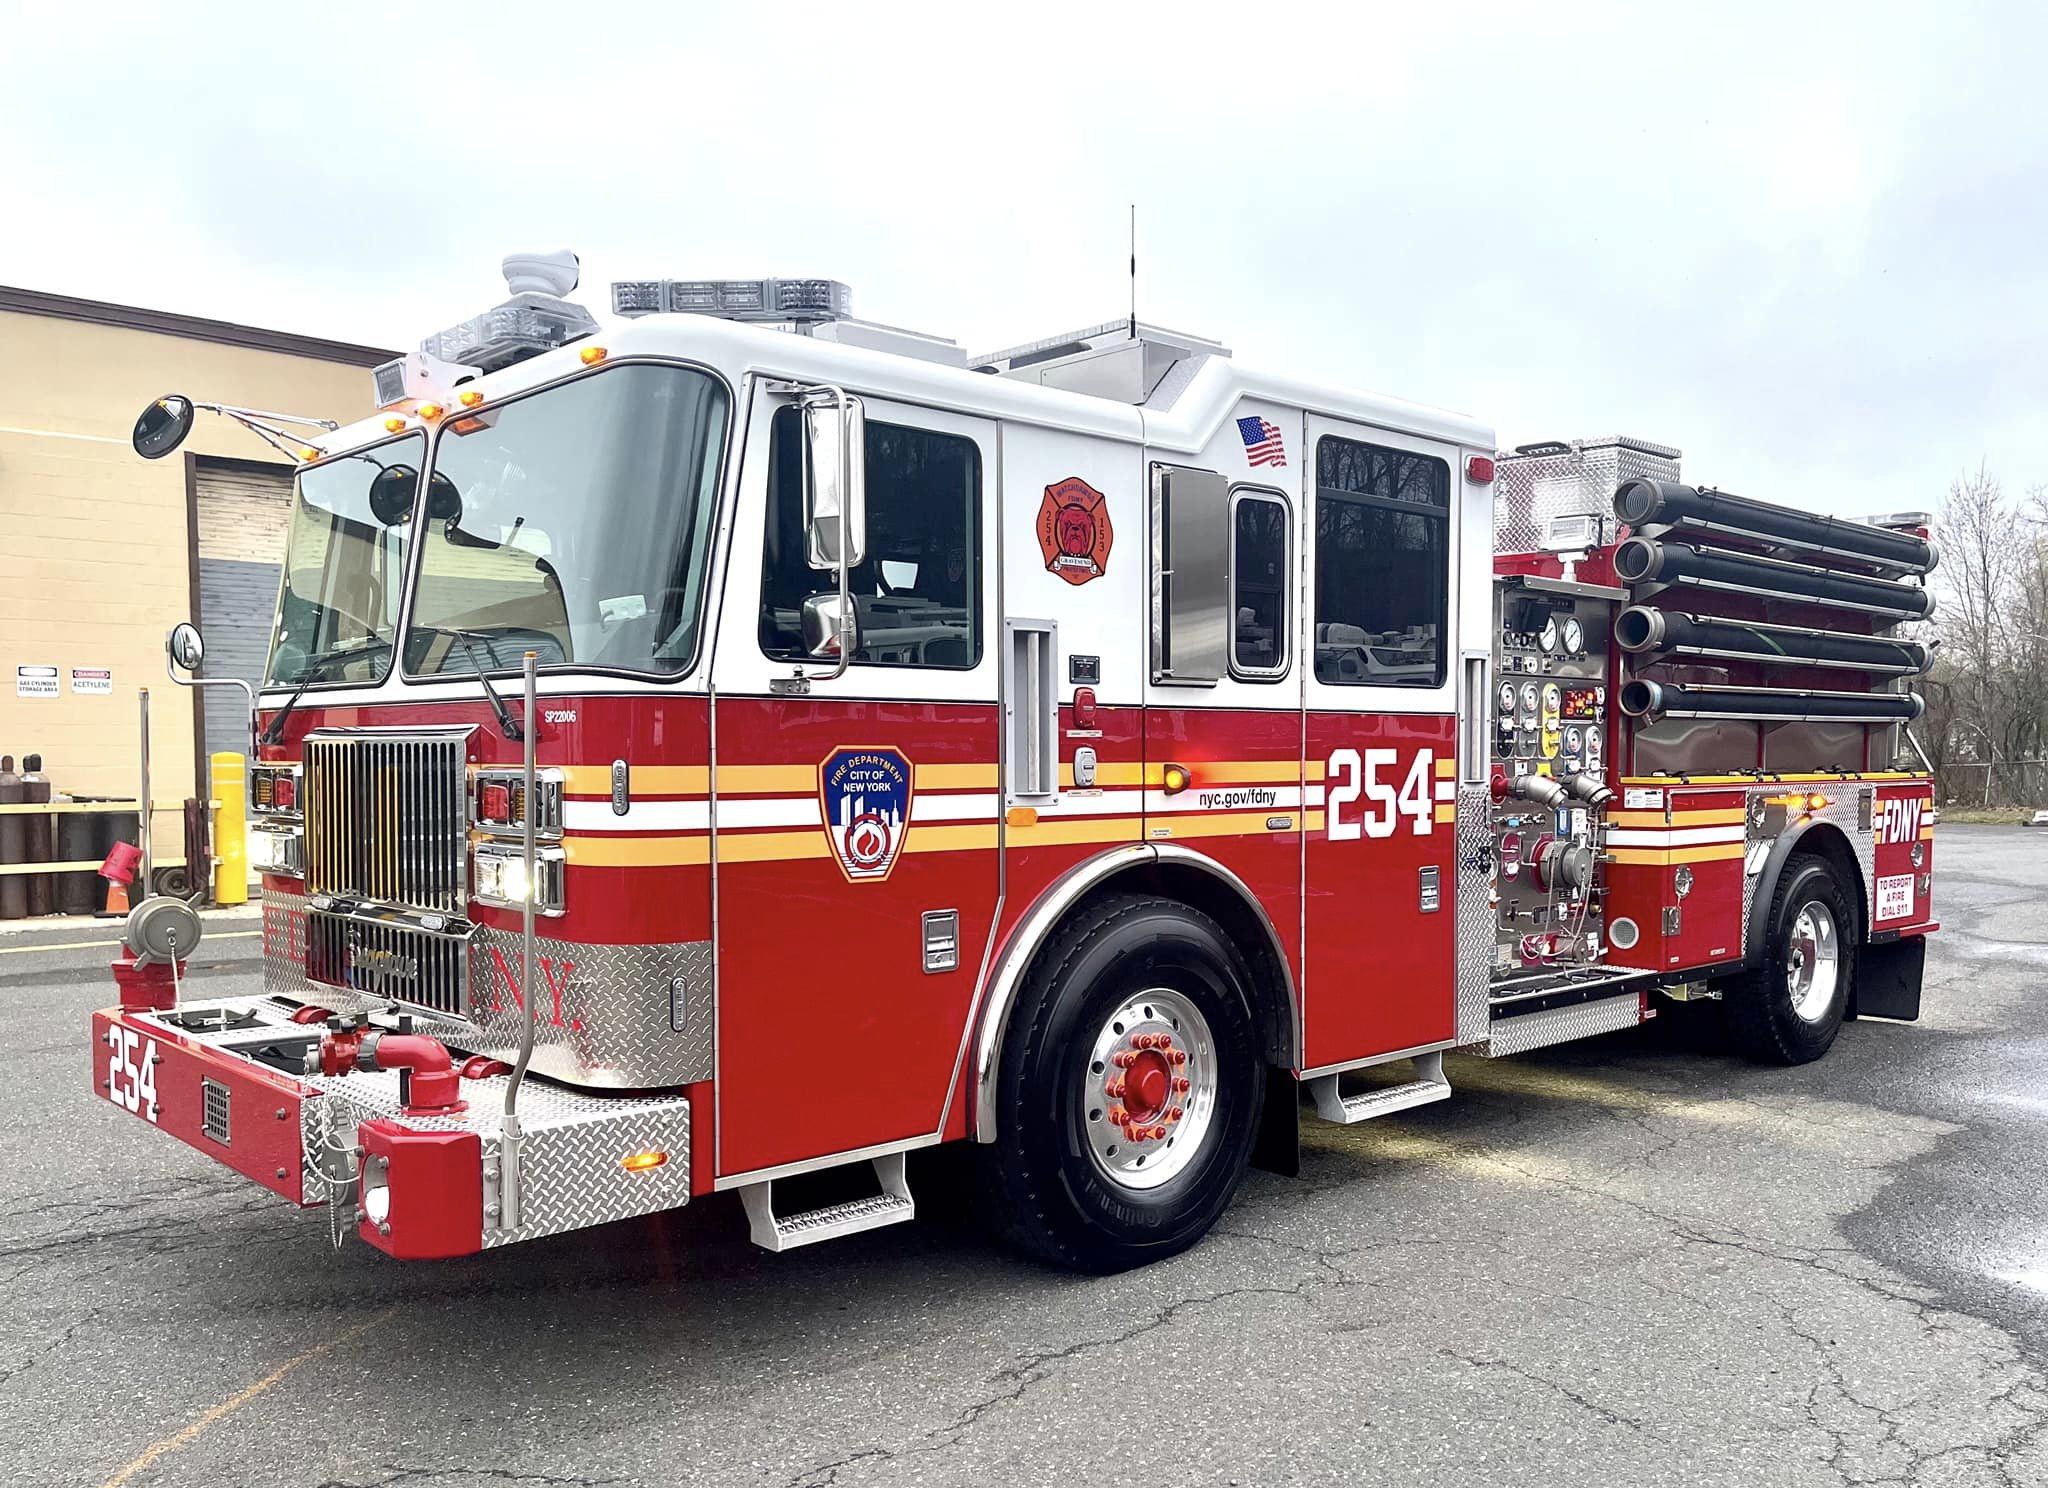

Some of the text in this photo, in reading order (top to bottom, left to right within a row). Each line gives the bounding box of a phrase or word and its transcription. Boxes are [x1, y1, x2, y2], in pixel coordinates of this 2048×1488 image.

[544, 710, 576, 723] SP22006
[831, 755, 903, 786] FIRE DEPARTMENT
[850, 770, 885, 780] CITY OF
[843, 782, 892, 793] NEW YORK
[1199, 788, 1276, 809] nyc.gov/fdny
[1328, 748, 1433, 841] 254
[1882, 799, 1922, 844] FDNY
[1880, 877, 1912, 890] TO REPORT
[1886, 890, 1905, 902] A FIRE
[1881, 904, 1908, 917] DIAL 911
[109, 1023, 158, 1123] 254
